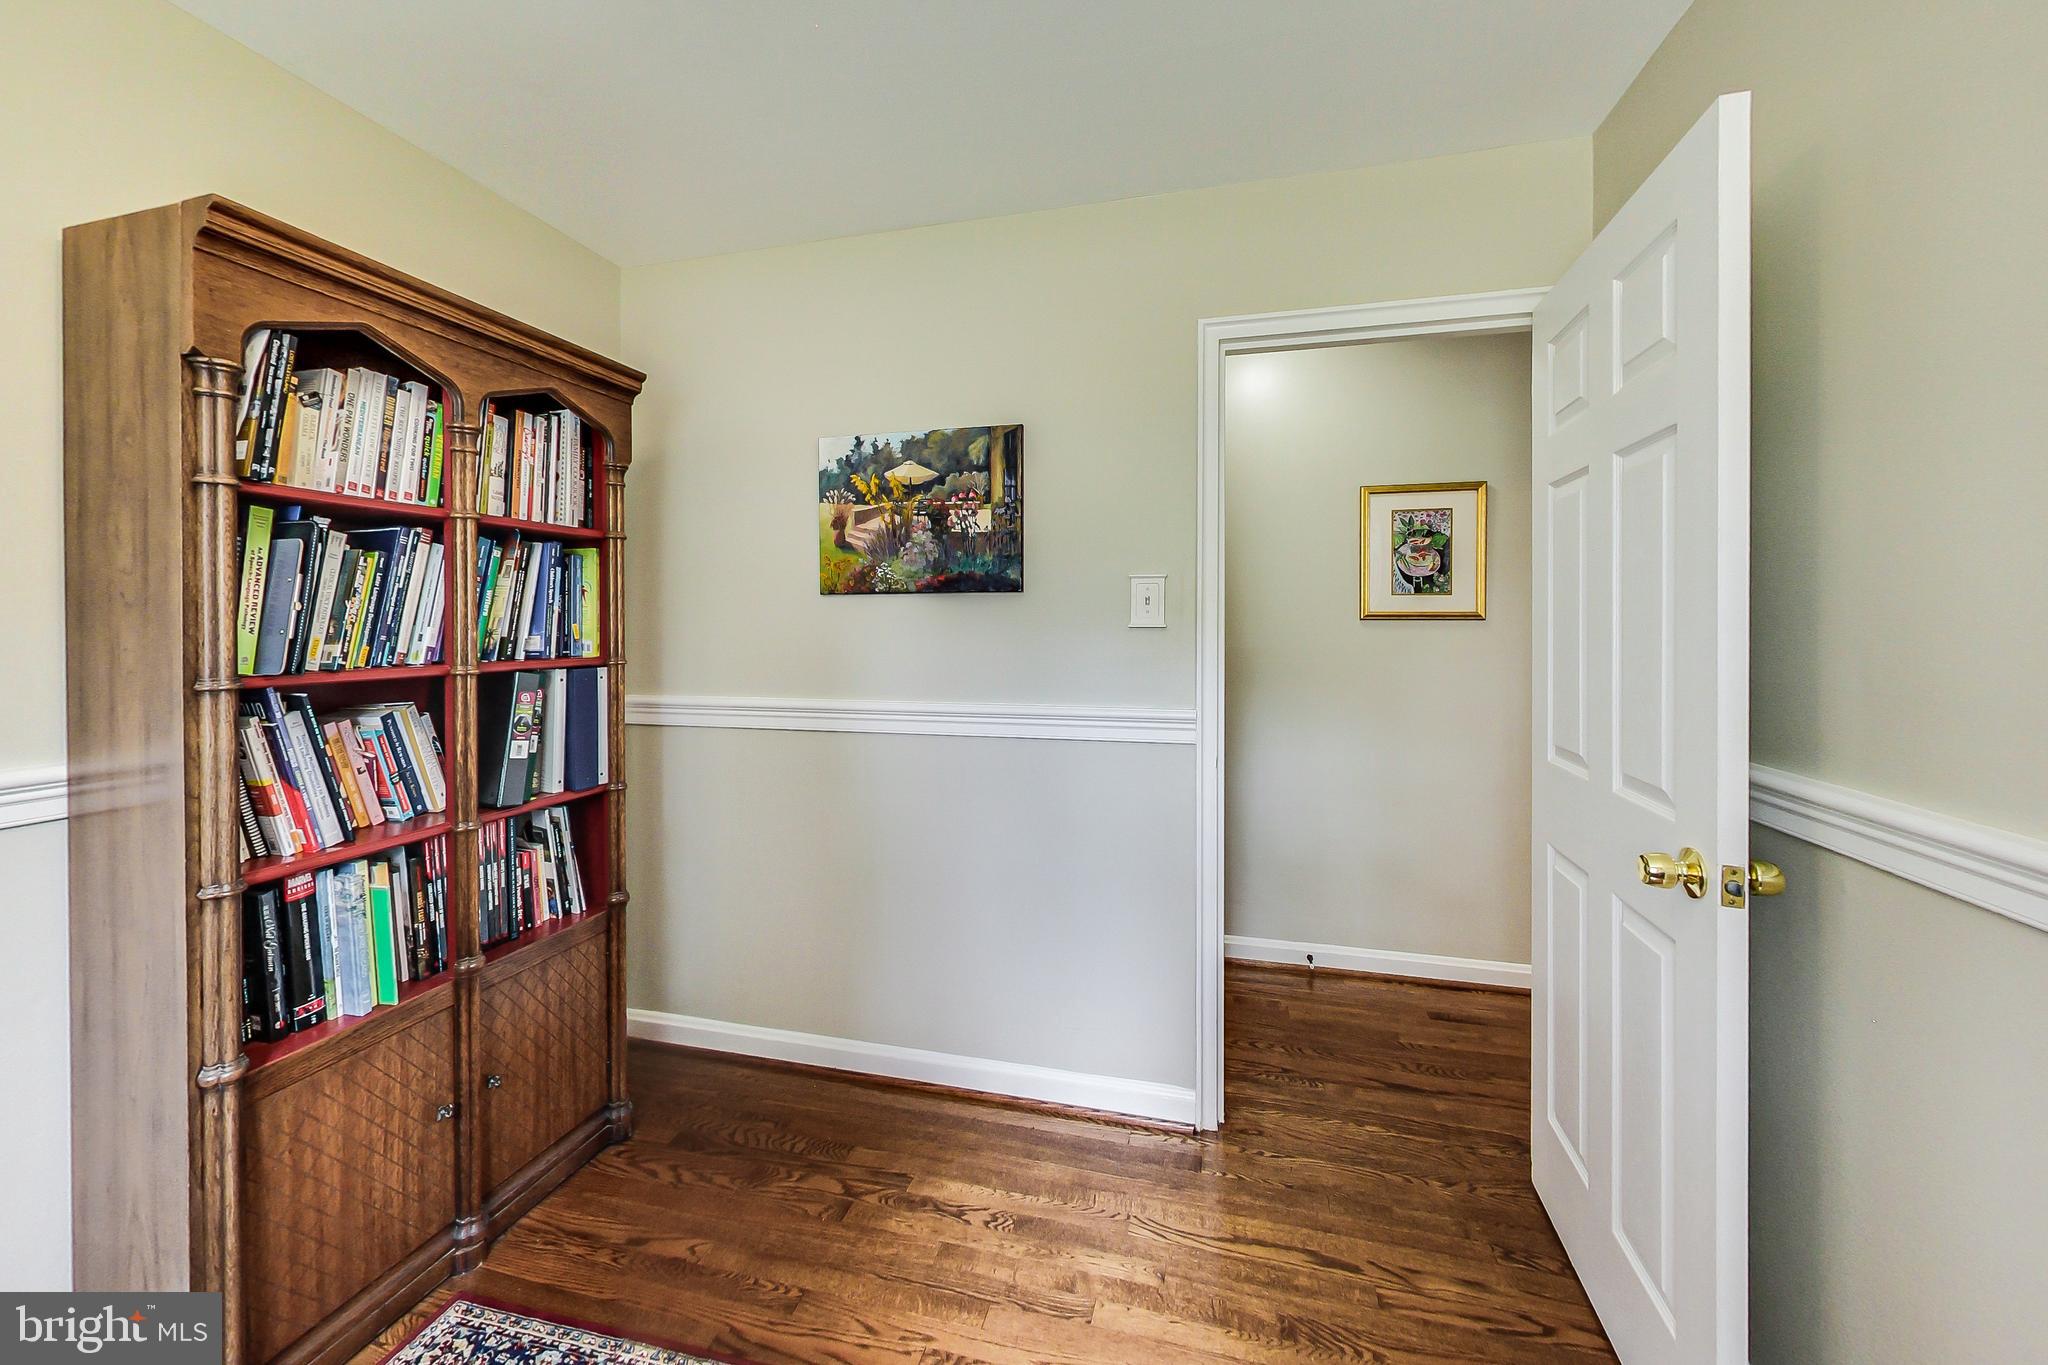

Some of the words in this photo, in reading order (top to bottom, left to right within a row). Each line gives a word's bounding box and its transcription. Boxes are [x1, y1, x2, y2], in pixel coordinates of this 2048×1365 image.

[382, 395, 396, 426] DINNER
[353, 400, 367, 455] MEDITERRANEAN
[411, 417, 420, 444] COOKING
[338, 425, 351, 462] WONDERS
[422, 434, 432, 457] quick
[431, 433, 443, 479] VEGETARIAN
[420, 456, 428, 479] quicker
[251, 554, 263, 599] ADVANCED
[373, 571, 383, 587] Later
[367, 586, 380, 613] Language
[481, 588, 493, 617] Writers
[240, 603, 249, 630] Pathology
[247, 601, 258, 635] REVIEW
[297, 747, 310, 771] Learning
[298, 733, 311, 757] Teaching
[305, 755, 322, 789] Mathematics
[319, 794, 332, 818] Students
[288, 872, 313, 888] MARVEL
